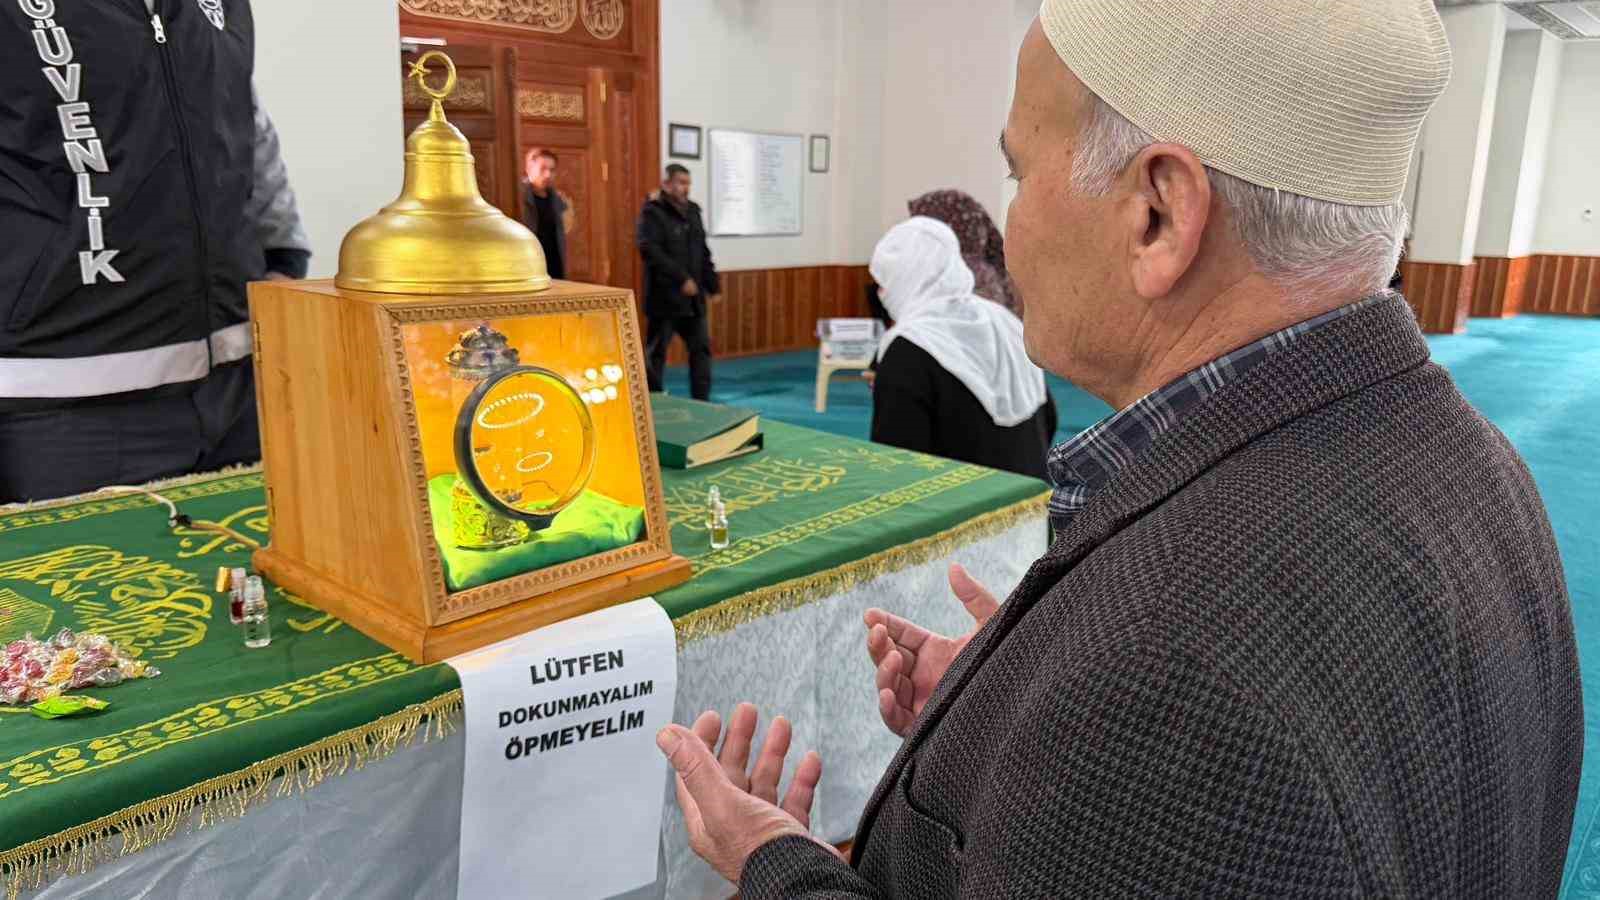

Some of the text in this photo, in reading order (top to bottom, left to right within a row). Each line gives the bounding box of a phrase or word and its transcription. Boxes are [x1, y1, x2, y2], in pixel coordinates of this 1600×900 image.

[530, 649, 624, 684] LÜTFEN
[498, 680, 653, 728] DOKUNMAYALIM
[504, 710, 645, 760] ÖPMEYELİM
